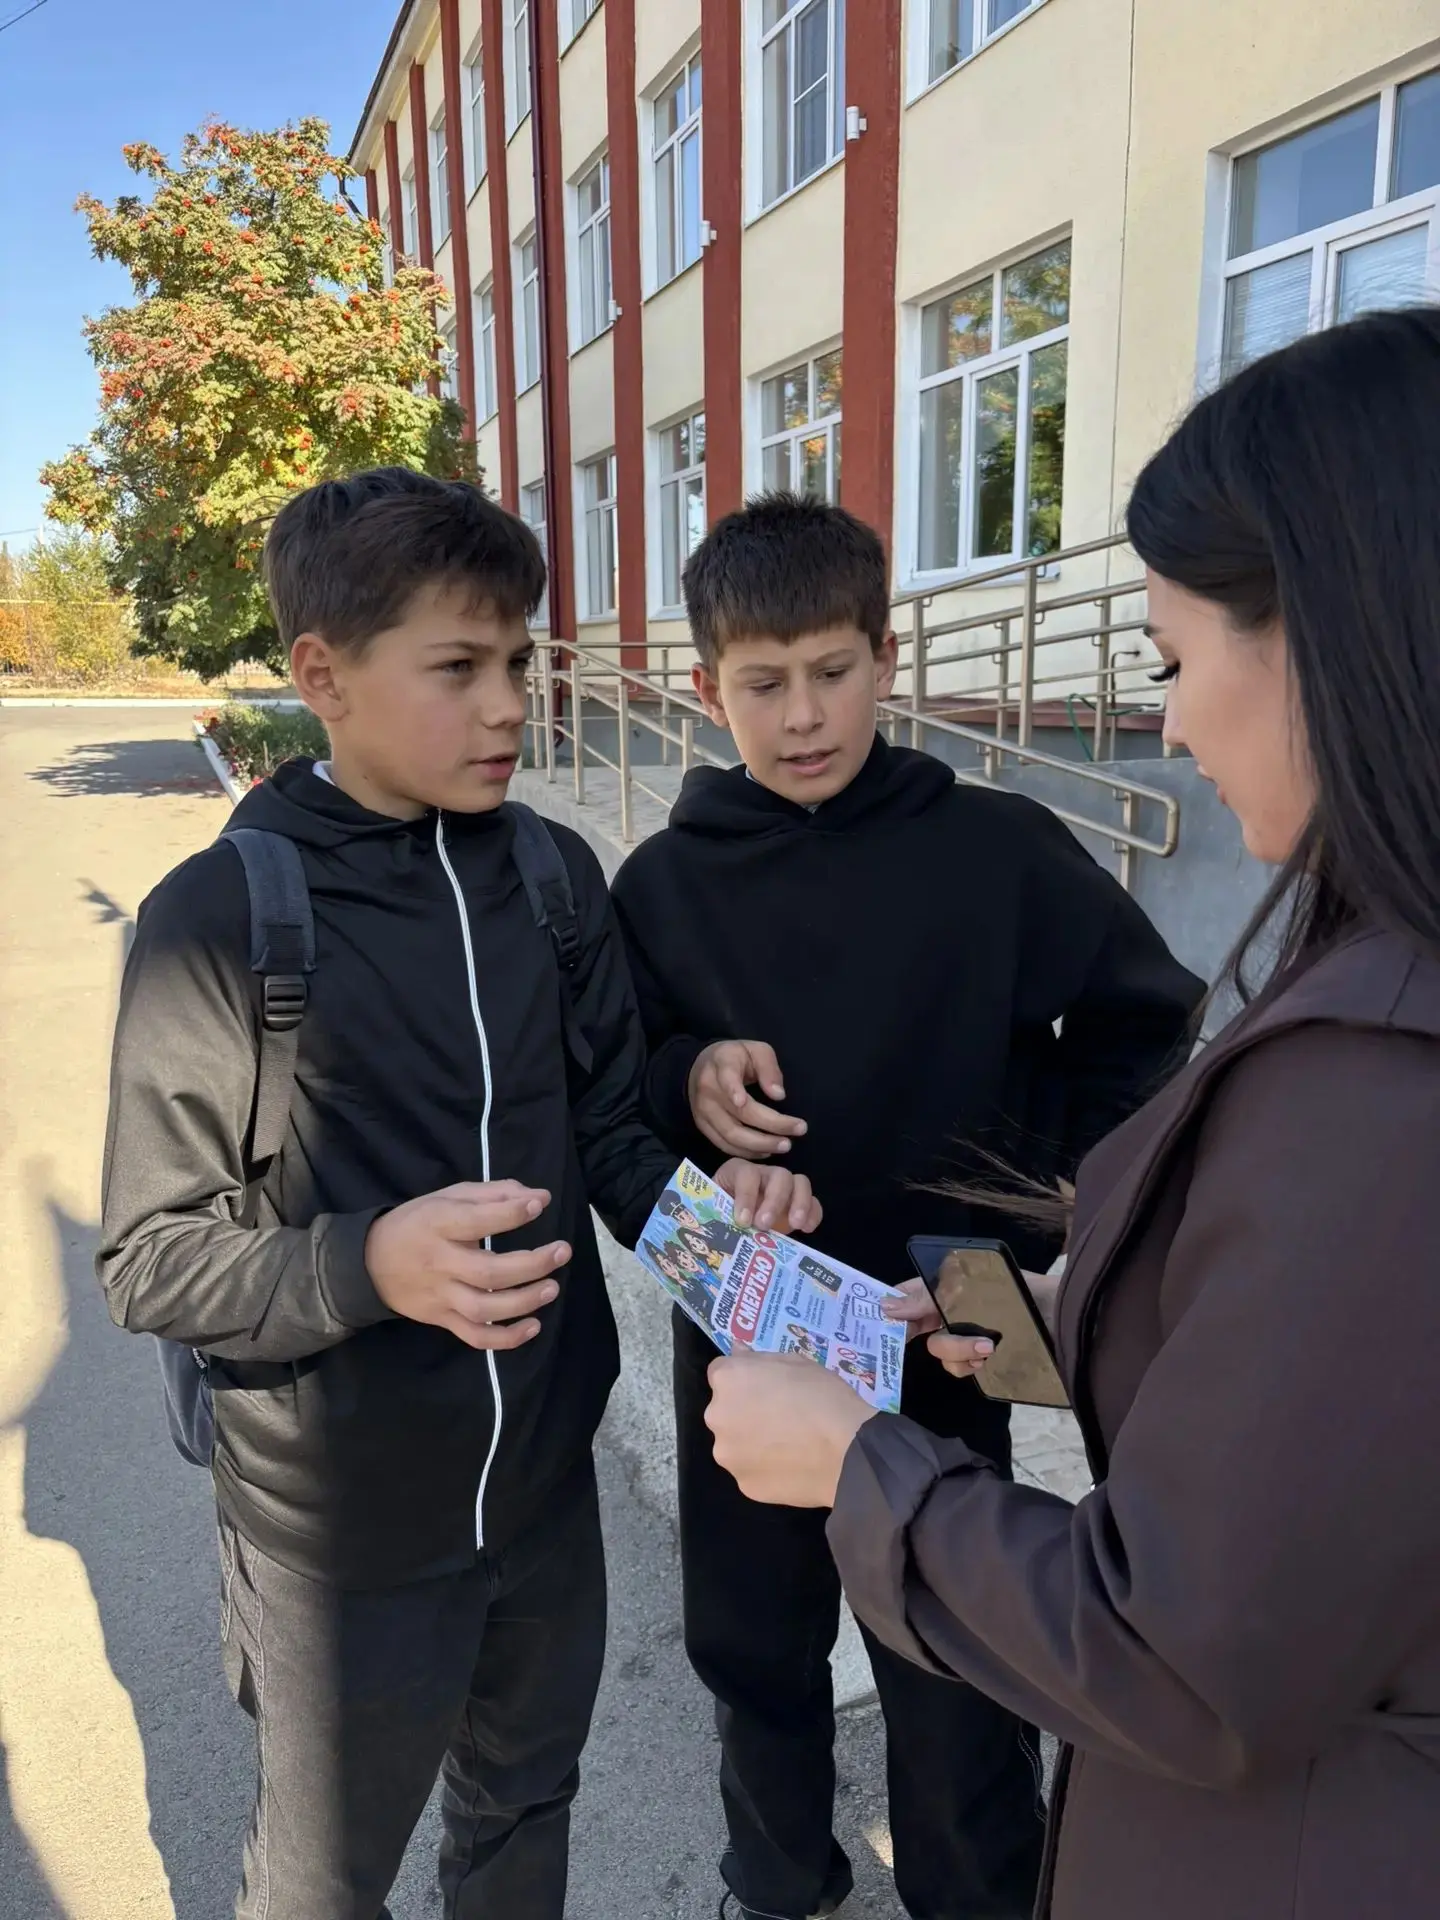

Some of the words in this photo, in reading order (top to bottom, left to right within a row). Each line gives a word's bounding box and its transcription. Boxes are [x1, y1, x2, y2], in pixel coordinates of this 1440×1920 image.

[732, 1239, 755, 1275] ТОРГУЮТ
[726, 1270, 741, 1290] ГДЕ
[736, 1256, 772, 1330] СМЕРТЬЮ
[825, 1275, 835, 1285] 112
[715, 1289, 737, 1329] СООБЩИ,
